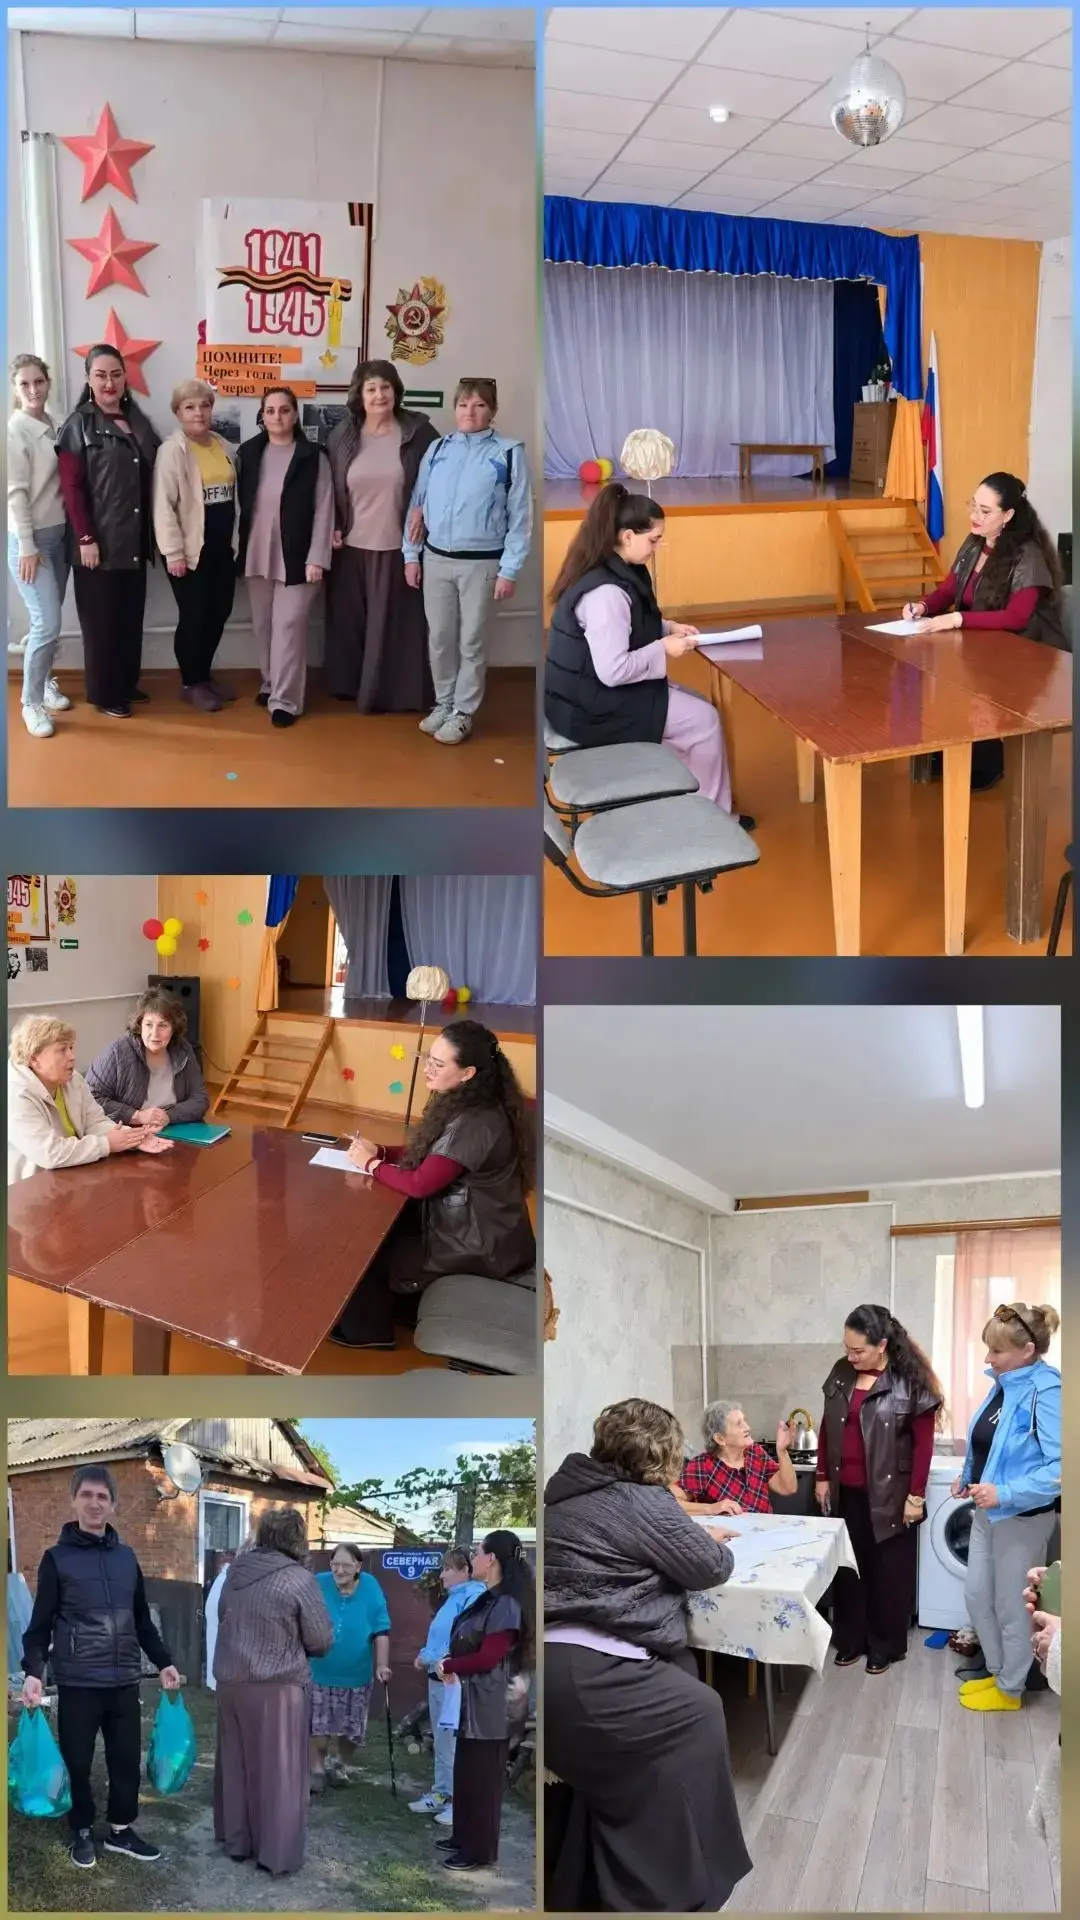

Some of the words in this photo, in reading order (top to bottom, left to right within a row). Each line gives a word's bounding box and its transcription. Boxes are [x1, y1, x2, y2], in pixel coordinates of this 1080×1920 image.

[245, 229, 321, 277] 1941
[245, 286, 325, 336] 1945
[203, 351, 282, 364] ПОМНИТЕ!
[203, 365, 239, 379] Через
[222, 385, 255, 396] через
[386, 1556, 438, 1566] СЕВЕРНАЯ
[408, 1566, 415, 1577] 9
